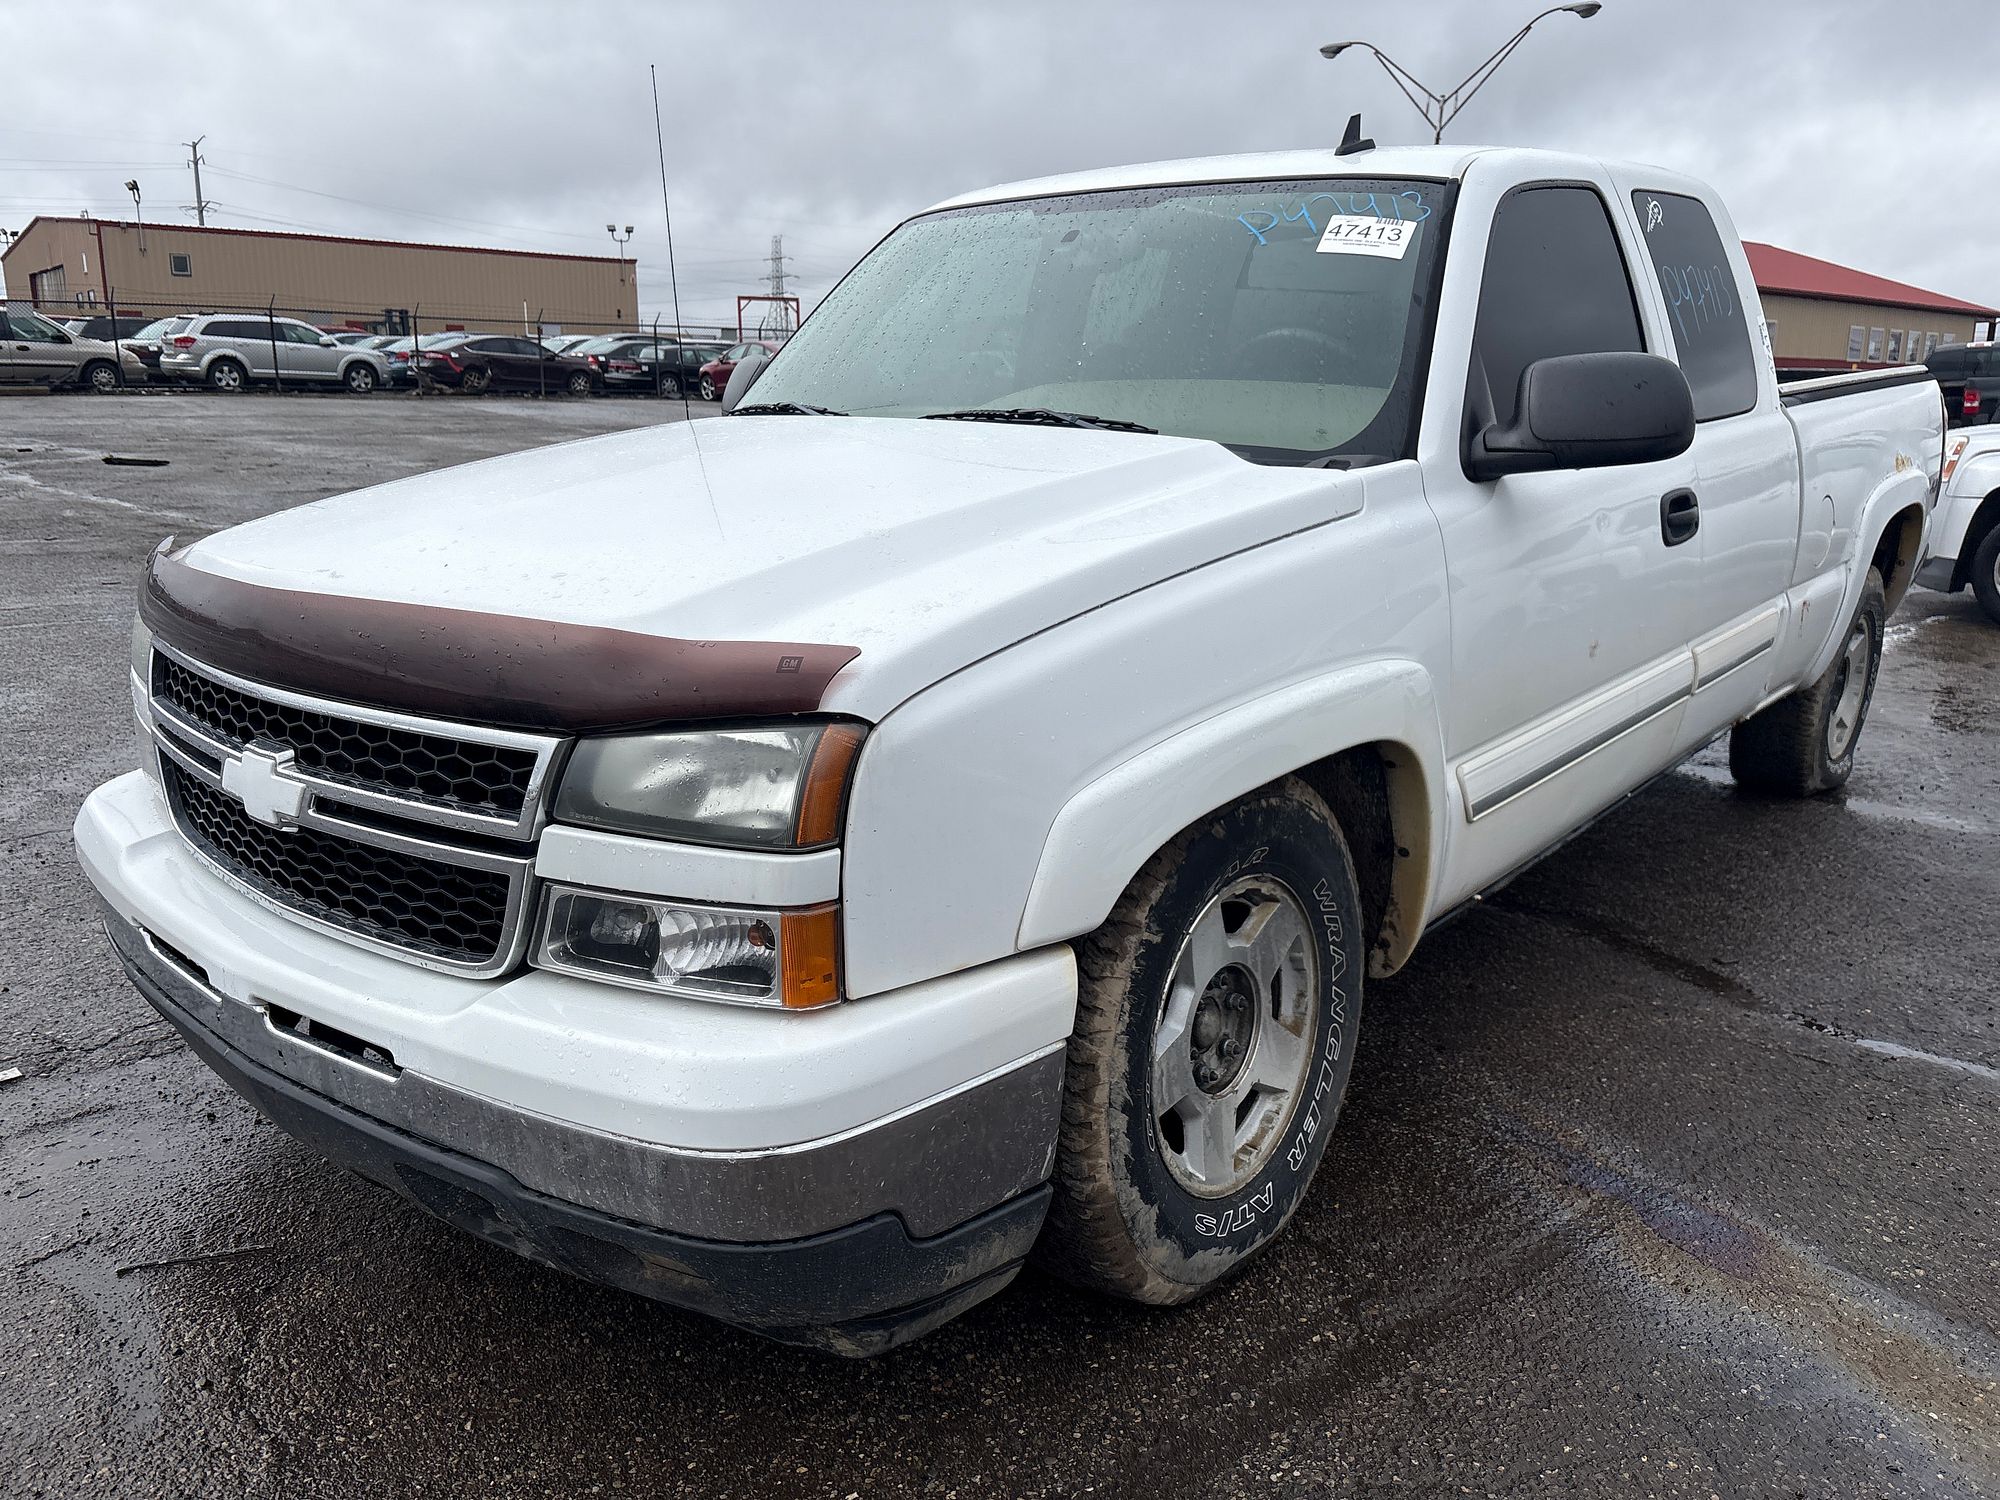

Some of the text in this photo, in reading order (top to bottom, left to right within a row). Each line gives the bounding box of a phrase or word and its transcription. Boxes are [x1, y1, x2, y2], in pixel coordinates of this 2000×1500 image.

[1327, 224, 1402, 242] 47413
[782, 658, 799, 668] GM
[1287, 878, 1347, 1171] WRANGLER
